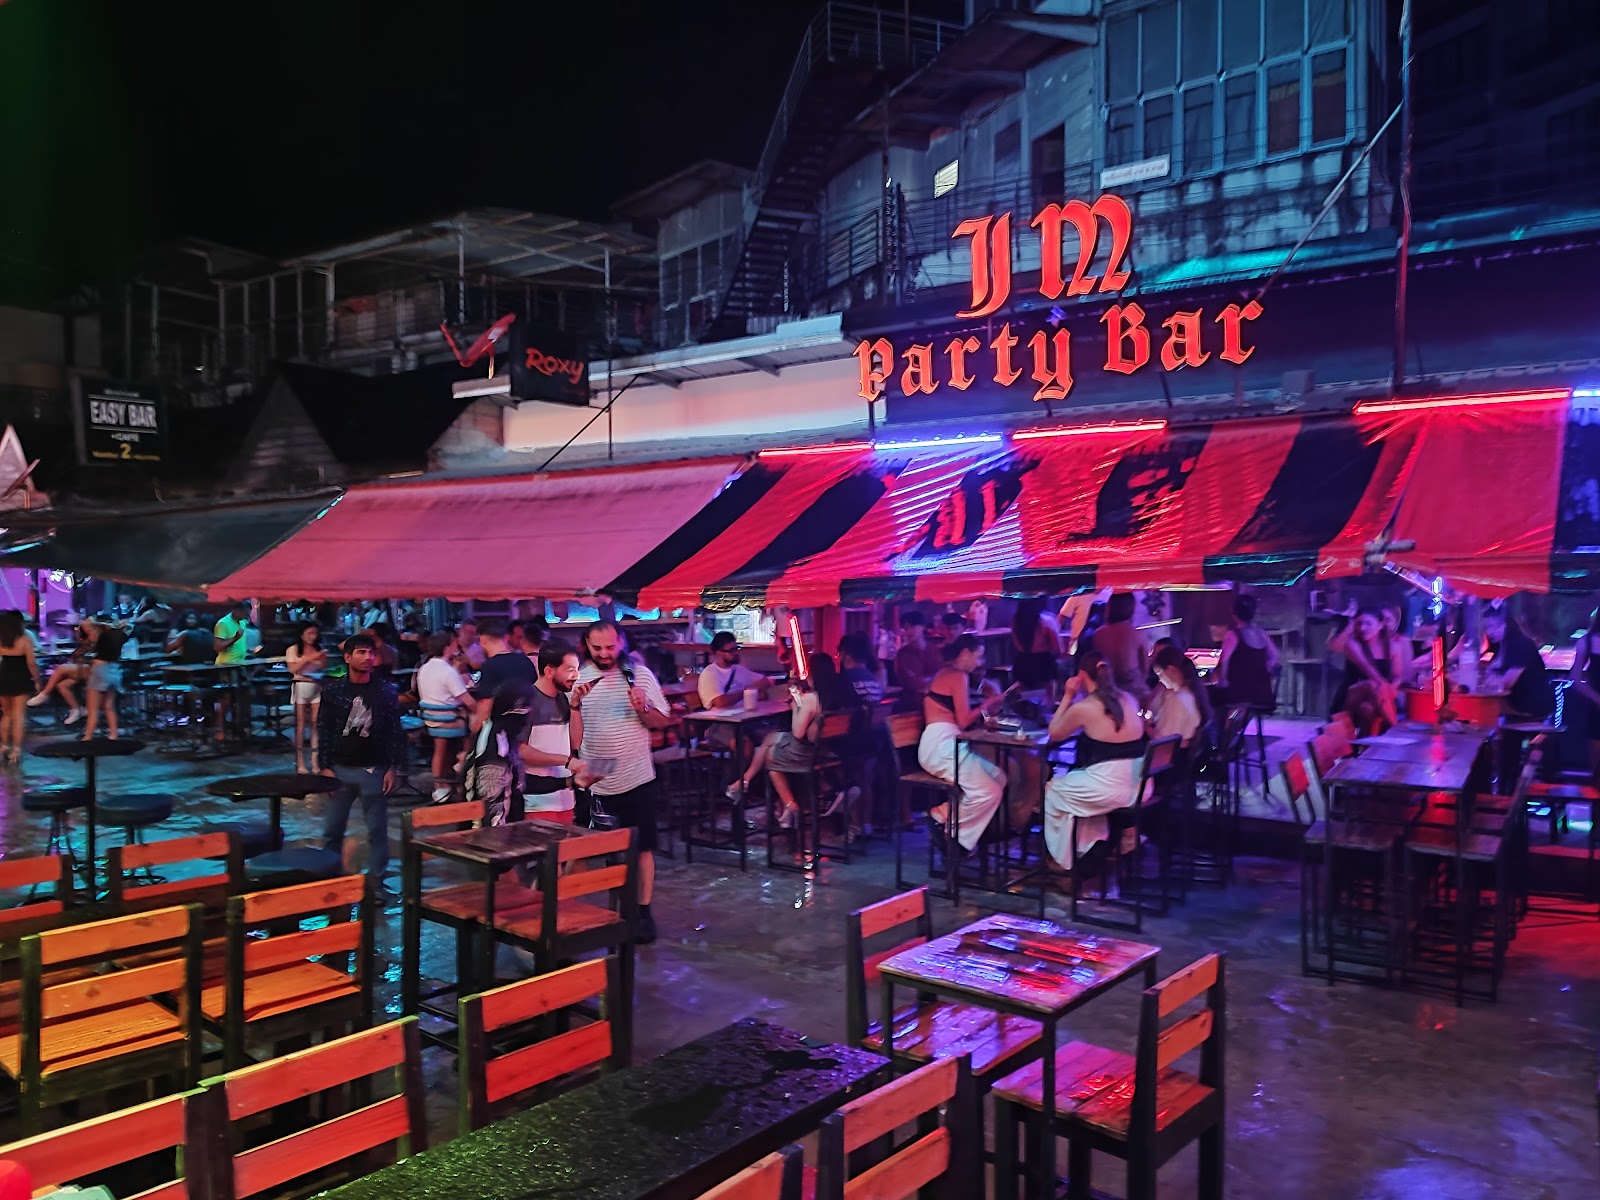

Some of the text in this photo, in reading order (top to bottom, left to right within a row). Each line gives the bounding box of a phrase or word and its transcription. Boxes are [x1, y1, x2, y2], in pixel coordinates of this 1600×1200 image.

[952, 193, 1132, 319] JM
[1100, 299, 1265, 376] Bar
[90, 401, 157, 428] EASY BAR
[120, 442, 131, 459] 2
